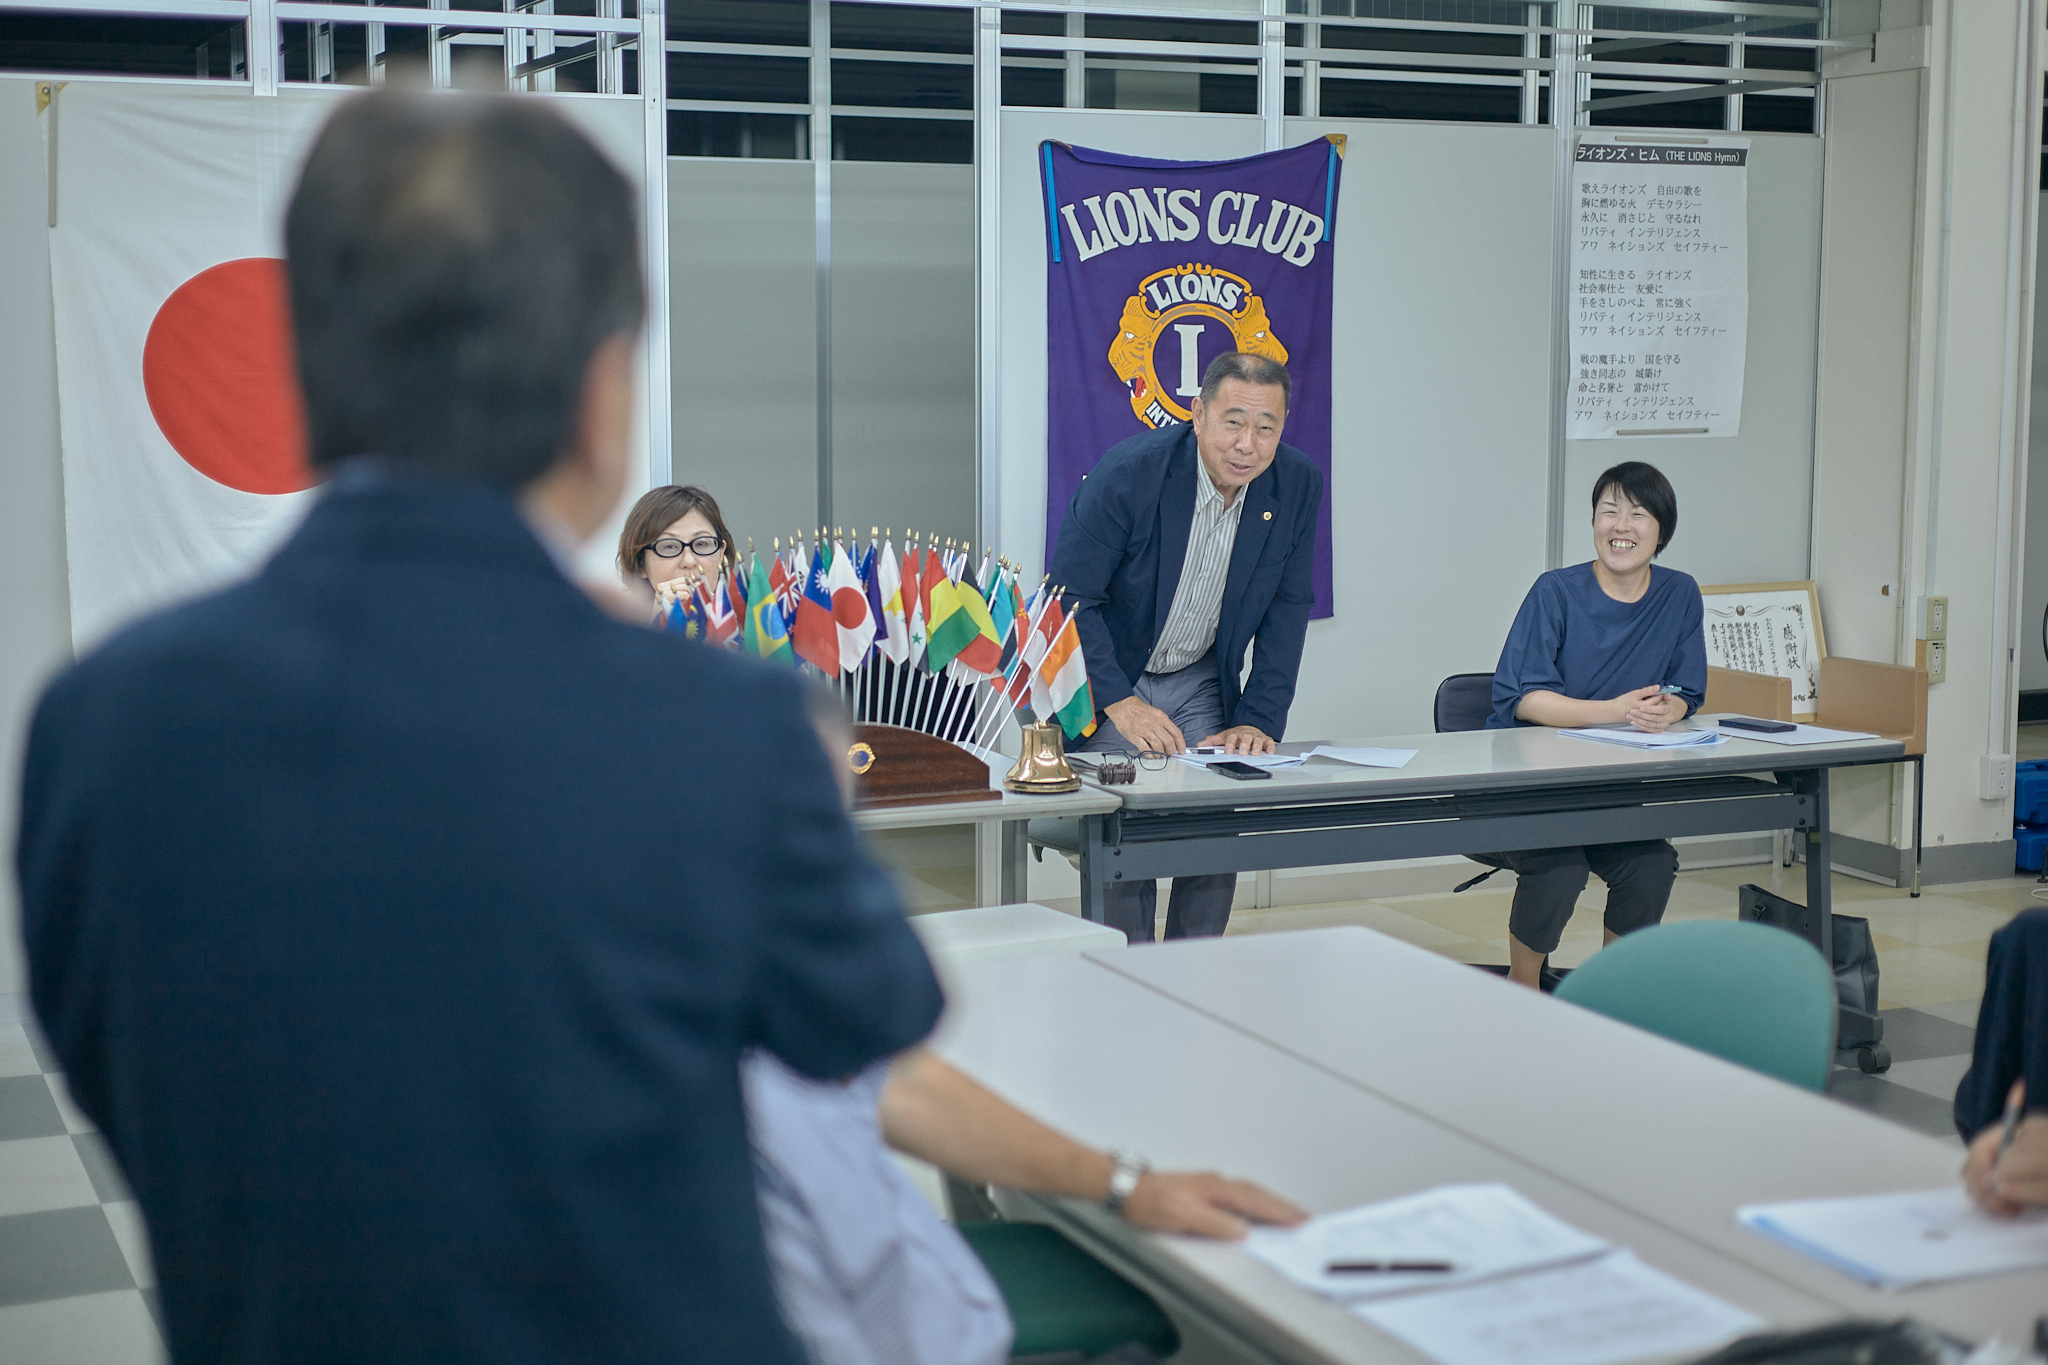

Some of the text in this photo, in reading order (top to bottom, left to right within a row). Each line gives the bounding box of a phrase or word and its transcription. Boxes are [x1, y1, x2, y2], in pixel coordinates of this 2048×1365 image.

[1578, 147, 1659, 161] ライオンズ・ヒム
[1688, 151, 1712, 162] LIONS
[1582, 183, 1702, 196] 歌えライオンズ 自由の歌を
[1581, 198, 1702, 209] 胸に燃ゆる火 デモクラシー
[1581, 212, 1702, 224] 永久に 消さじと 守るなれ
[1060, 188, 1325, 268] LIONS CLUB
[1581, 227, 1700, 238] リバティ インテリジェンス
[1581, 241, 1728, 252] アワ ネイションズ セイフティー
[1580, 269, 1692, 280] 知性に生きる ライオンズ
[1146, 274, 1244, 311] LIONS
[1579, 283, 1663, 294] 社会奉仕と 友愛に
[1579, 298, 1692, 308] 手をさしのべよ 常に強く
[1580, 312, 1701, 322] リバティ インテリジェンス
[1580, 326, 1726, 336] アワ ネイションズ セイフティー
[1581, 354, 1681, 364] 戦の魔手より 国を守る
[1580, 368, 1662, 379] 強き同志の 城築け
[1578, 382, 1670, 393] 命と名誉と 富かけて
[1577, 397, 1694, 406] リバティ インテリジェンス
[1574, 410, 1719, 420] アワ ネイションズ セイフティー
[1783, 624, 1801, 669] 感謝状
